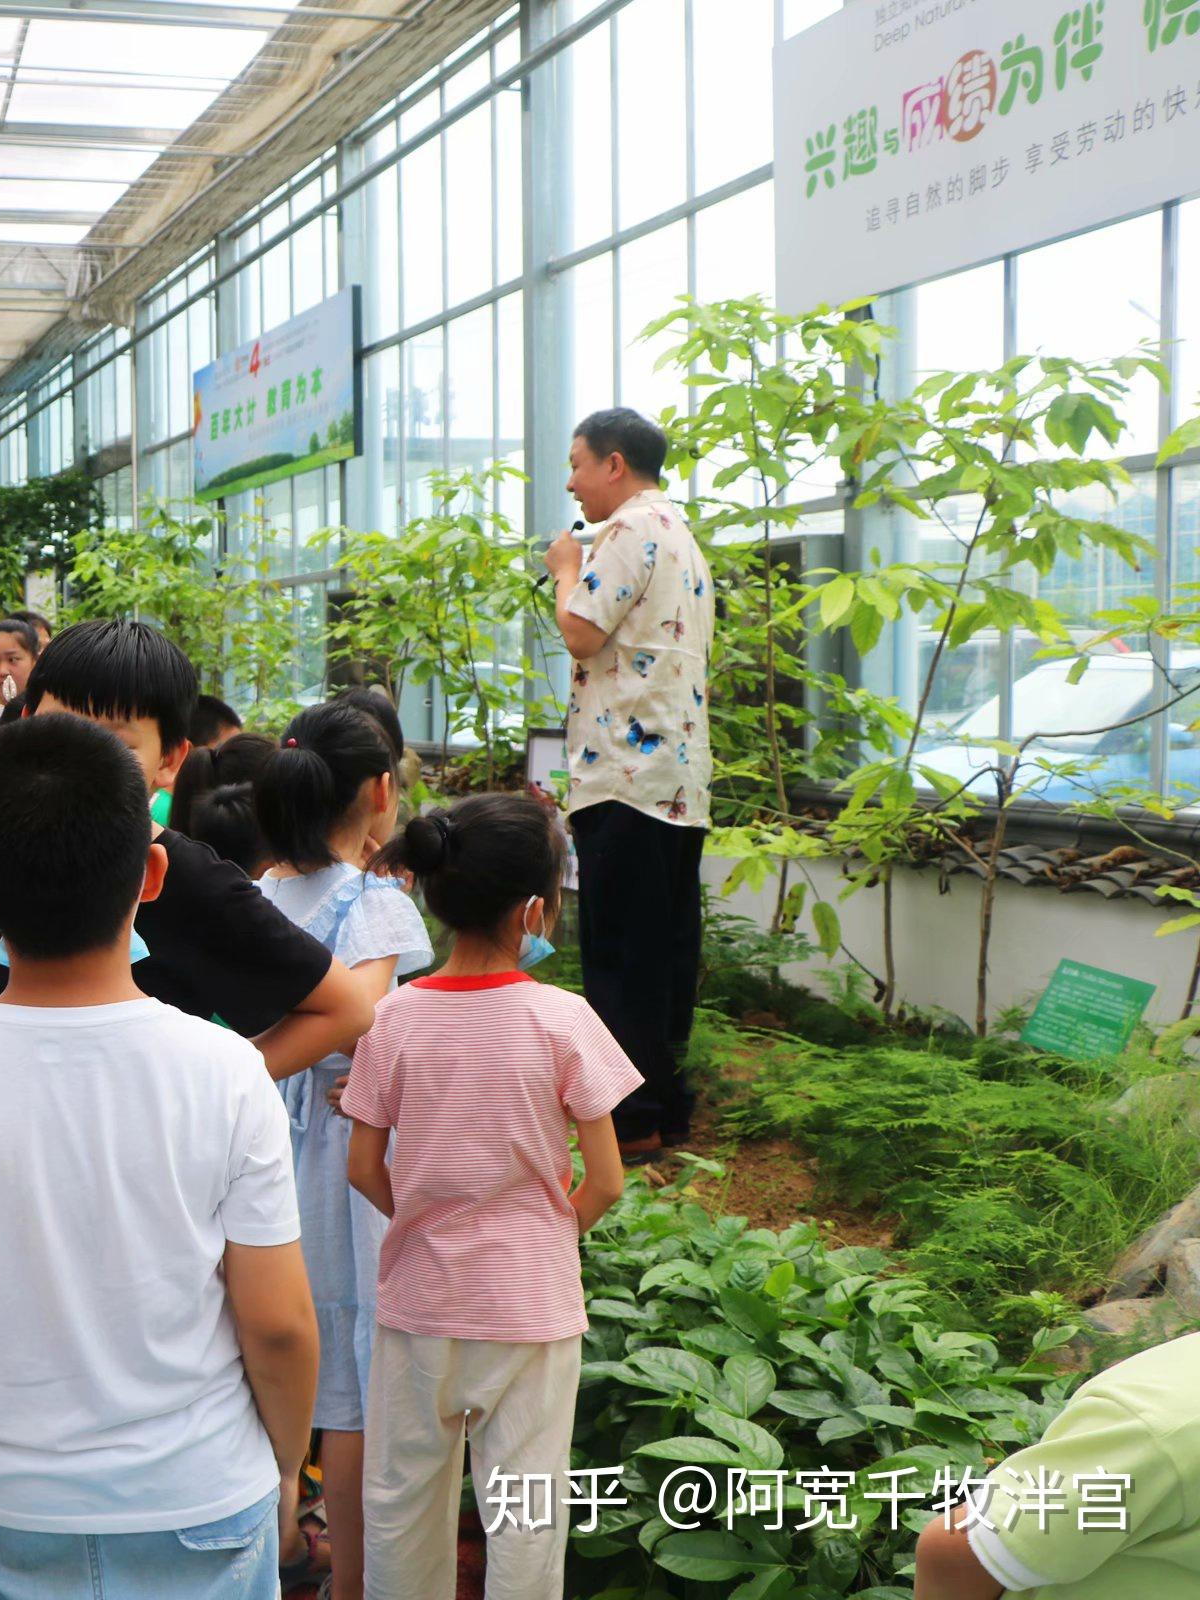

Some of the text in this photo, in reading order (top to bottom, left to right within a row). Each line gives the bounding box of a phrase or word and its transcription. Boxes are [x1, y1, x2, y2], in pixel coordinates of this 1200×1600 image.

[804, 0, 1104, 200] 兴趣与成绩为伴
[873, 0, 972, 51] Deep Natura
[866, 79, 1200, 232] 追寻自然的脚步 享受劳动的快
